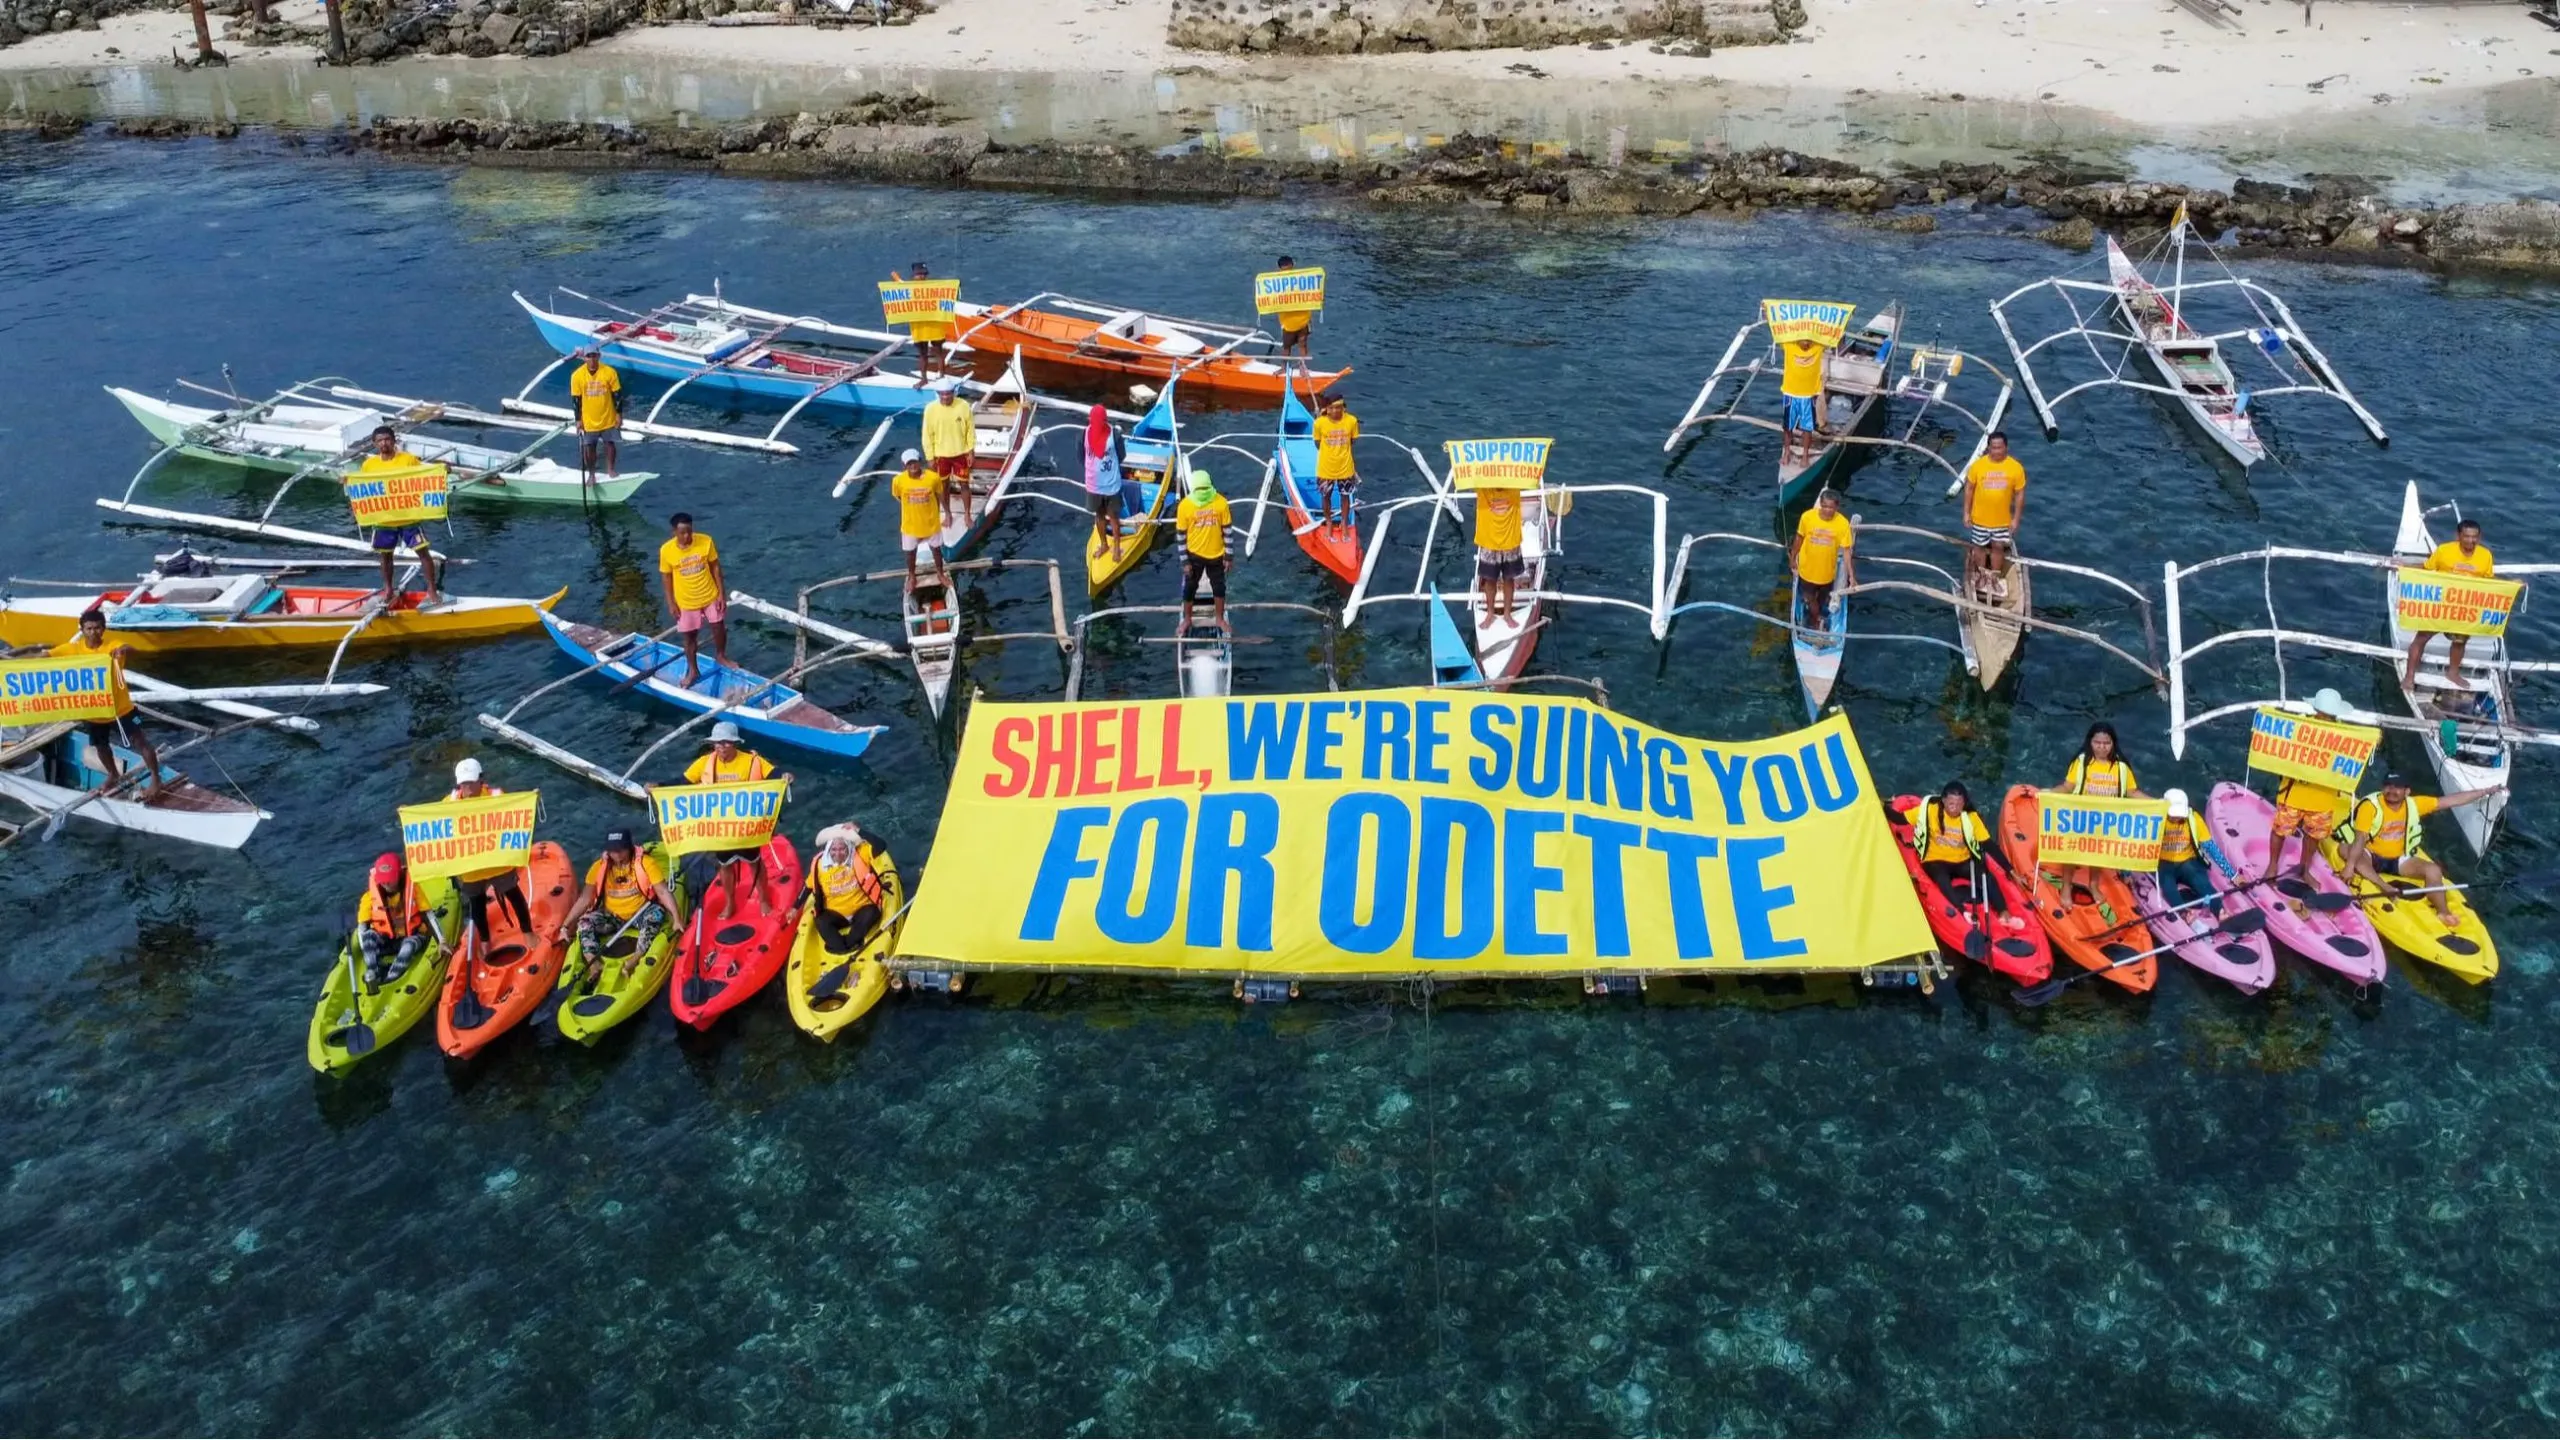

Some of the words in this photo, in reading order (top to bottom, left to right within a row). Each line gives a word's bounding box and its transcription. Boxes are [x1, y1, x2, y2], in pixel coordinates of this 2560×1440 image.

[882, 289, 911, 302] MAKE
[914, 288, 957, 300] CLIMATE
[1264, 275, 1323, 294] SUPPORT
[884, 300, 937, 314] POLLUTERS
[939, 300, 955, 312] PAY
[1273, 291, 1322, 305] #ODETTECAS
[1770, 305, 1776, 321] I
[1779, 303, 1849, 326] SUPPORT
[1452, 444, 1460, 463] I
[1463, 441, 1547, 464] SUPPORT
[1100, 459, 1113, 472] 30
[1454, 466, 1472, 480] THE
[349, 481, 386, 500] MAKE
[388, 475, 446, 495] CLIMATE
[351, 493, 421, 516] POLLUTERS
[423, 491, 446, 507] PAY
[2400, 582, 2443, 602] MAKE
[2445, 587, 2513, 612] CLIMATE
[2399, 600, 2479, 623] POLLUTERS
[2480, 609, 2508, 625] PAY
[5, 667, 108, 698] SUPPORT
[22, 693, 114, 714] #ODETTECASE
[2296, 722, 2372, 761] CLIMATE
[984, 705, 1212, 798] SHELL,
[1227, 700, 1452, 784] WE'RE
[1470, 704, 1694, 821] SUING
[1701, 733, 1860, 825] YOU
[2251, 733, 2331, 770] OLLUTERS
[2331, 754, 2365, 779] PAY
[661, 799, 669, 825] I
[674, 790, 780, 821] SUPPORT
[404, 818, 453, 844] MAKE
[458, 809, 533, 836] CLIMATE
[663, 824, 685, 845] THE
[687, 818, 774, 838] #ODETTECASE
[2044, 808, 2051, 832] I
[2057, 808, 2164, 841] SUPPORT
[407, 832, 497, 867] POLLUTERS
[500, 831, 531, 850] PAY
[2040, 834, 2065, 851] THE
[1020, 792, 1280, 952] FOR
[1320, 791, 1809, 961] ODETTE
